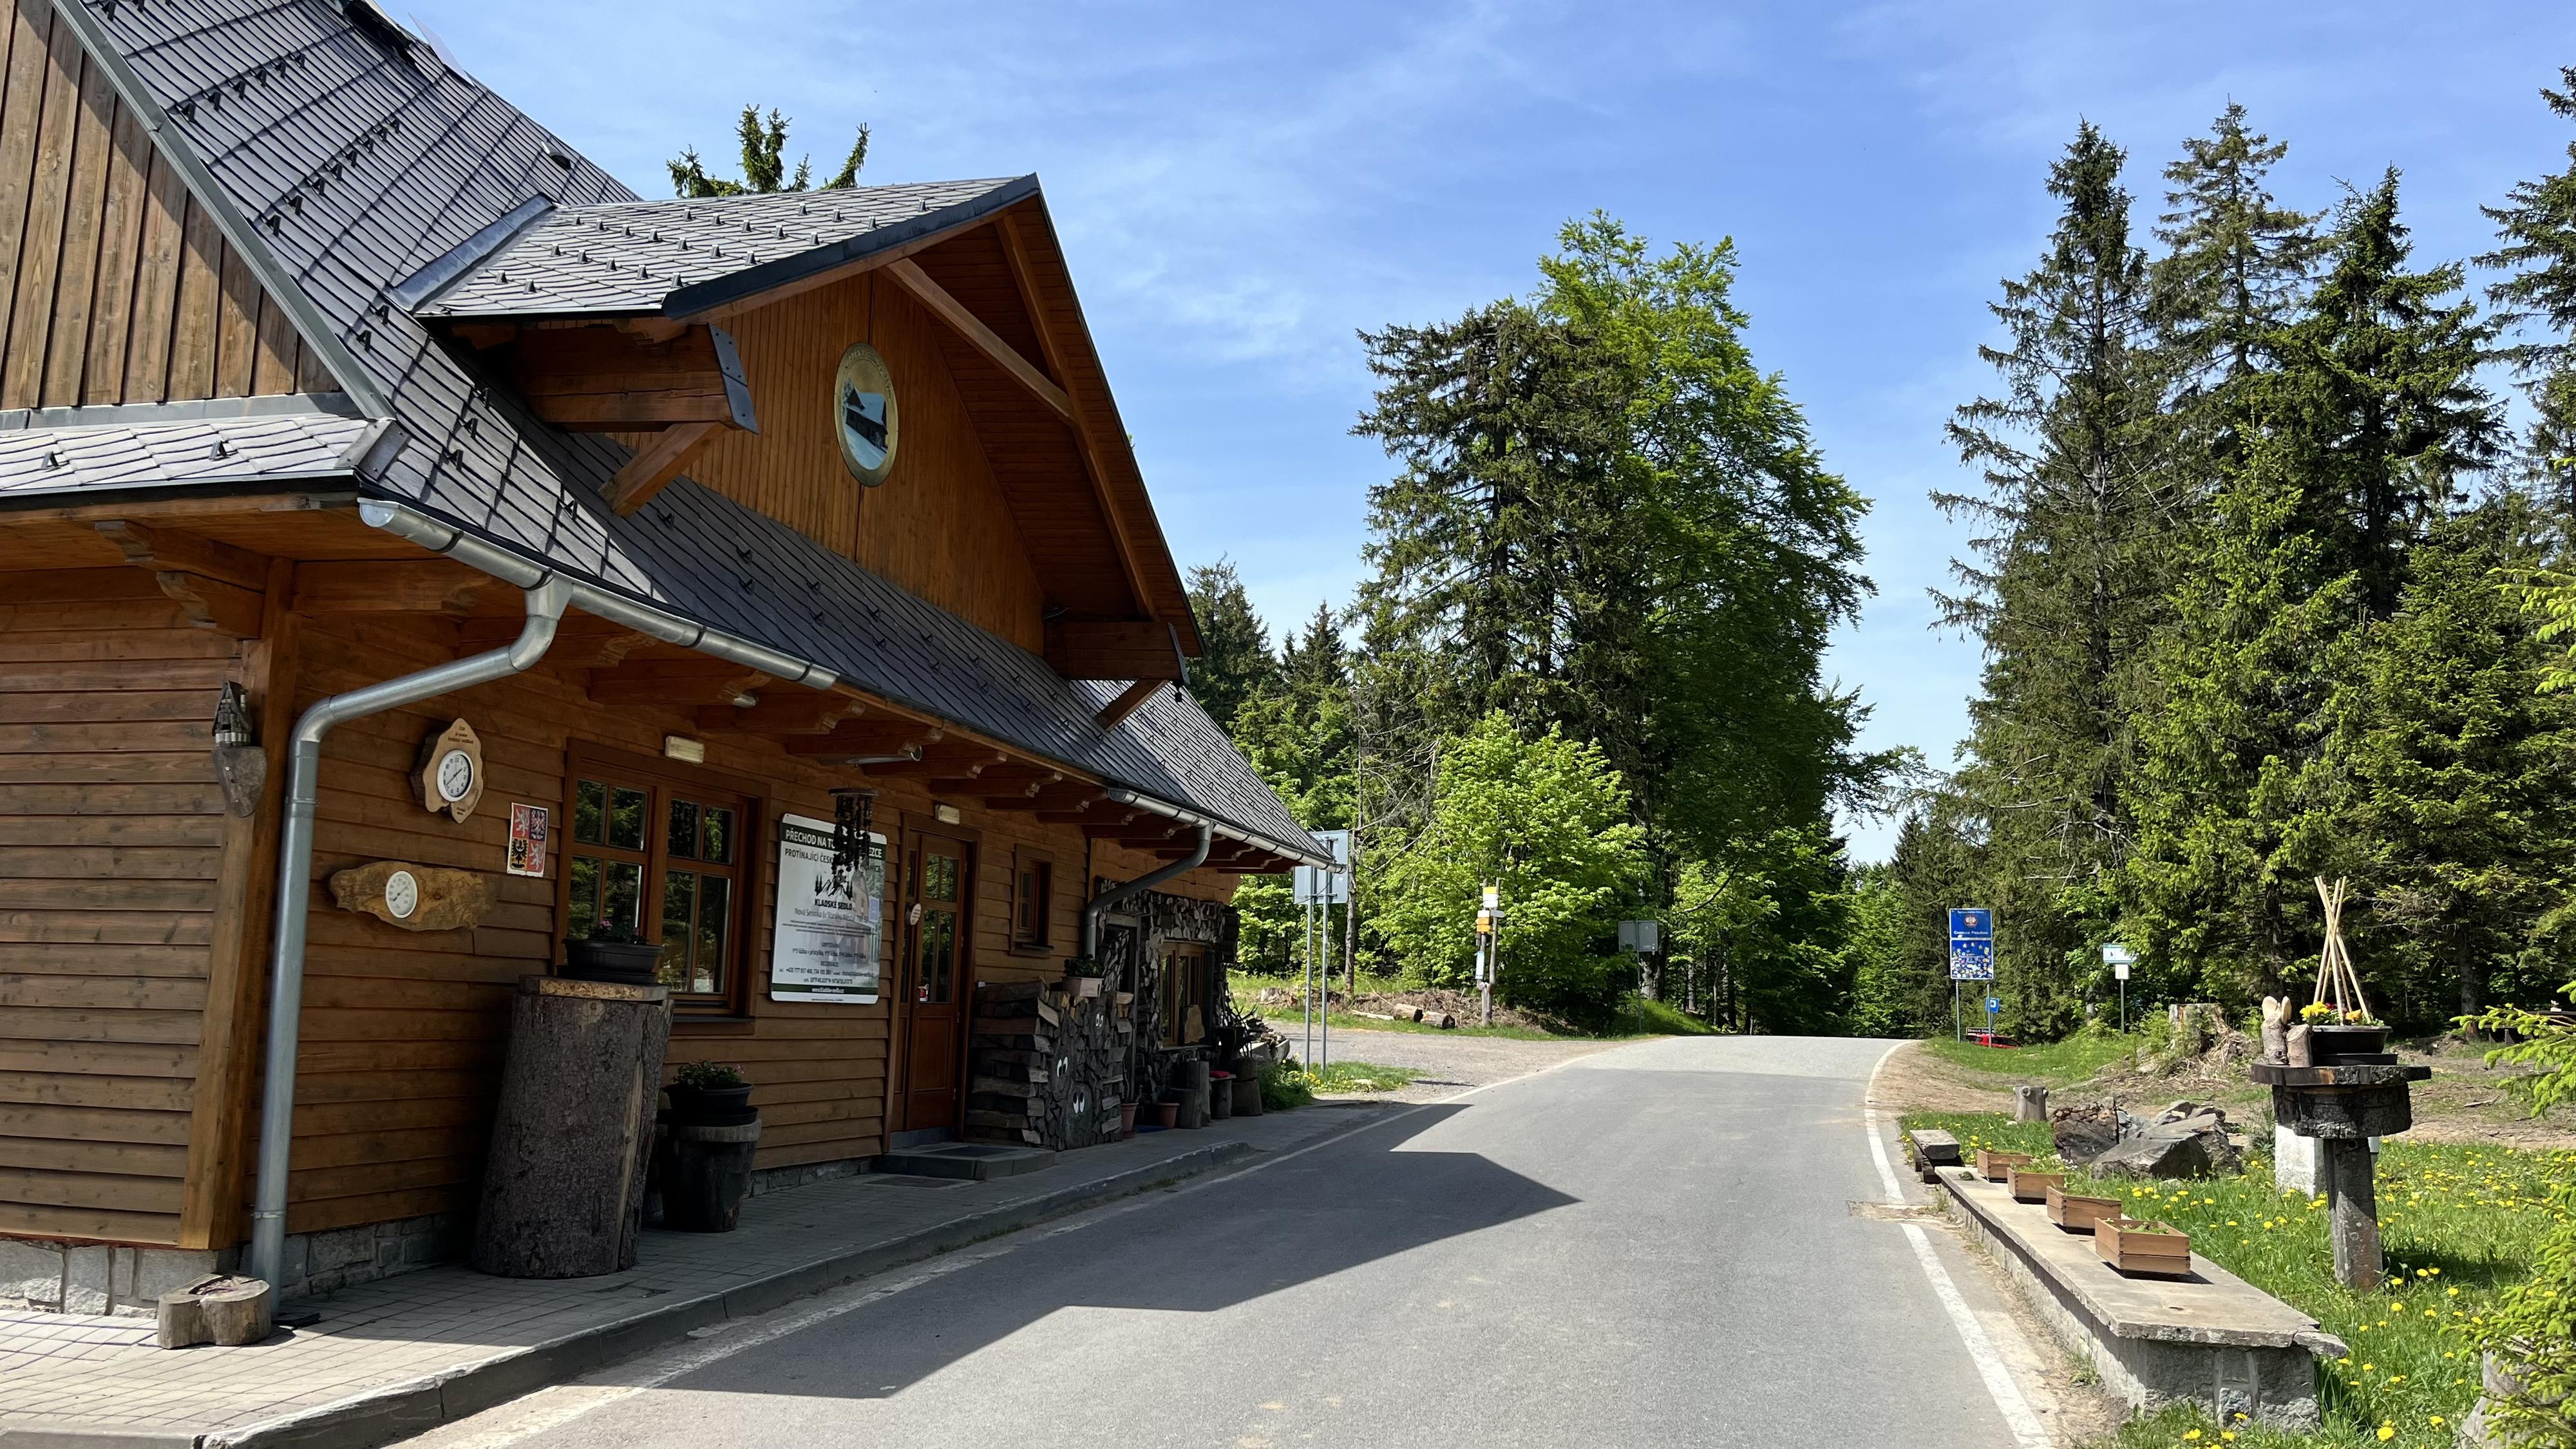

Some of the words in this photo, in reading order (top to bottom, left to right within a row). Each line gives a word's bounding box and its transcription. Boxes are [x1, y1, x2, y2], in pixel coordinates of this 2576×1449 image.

[786, 828, 817, 845] PŘECHOD
[817, 836, 827, 848] NA
[838, 902, 853, 911] SEDLO
